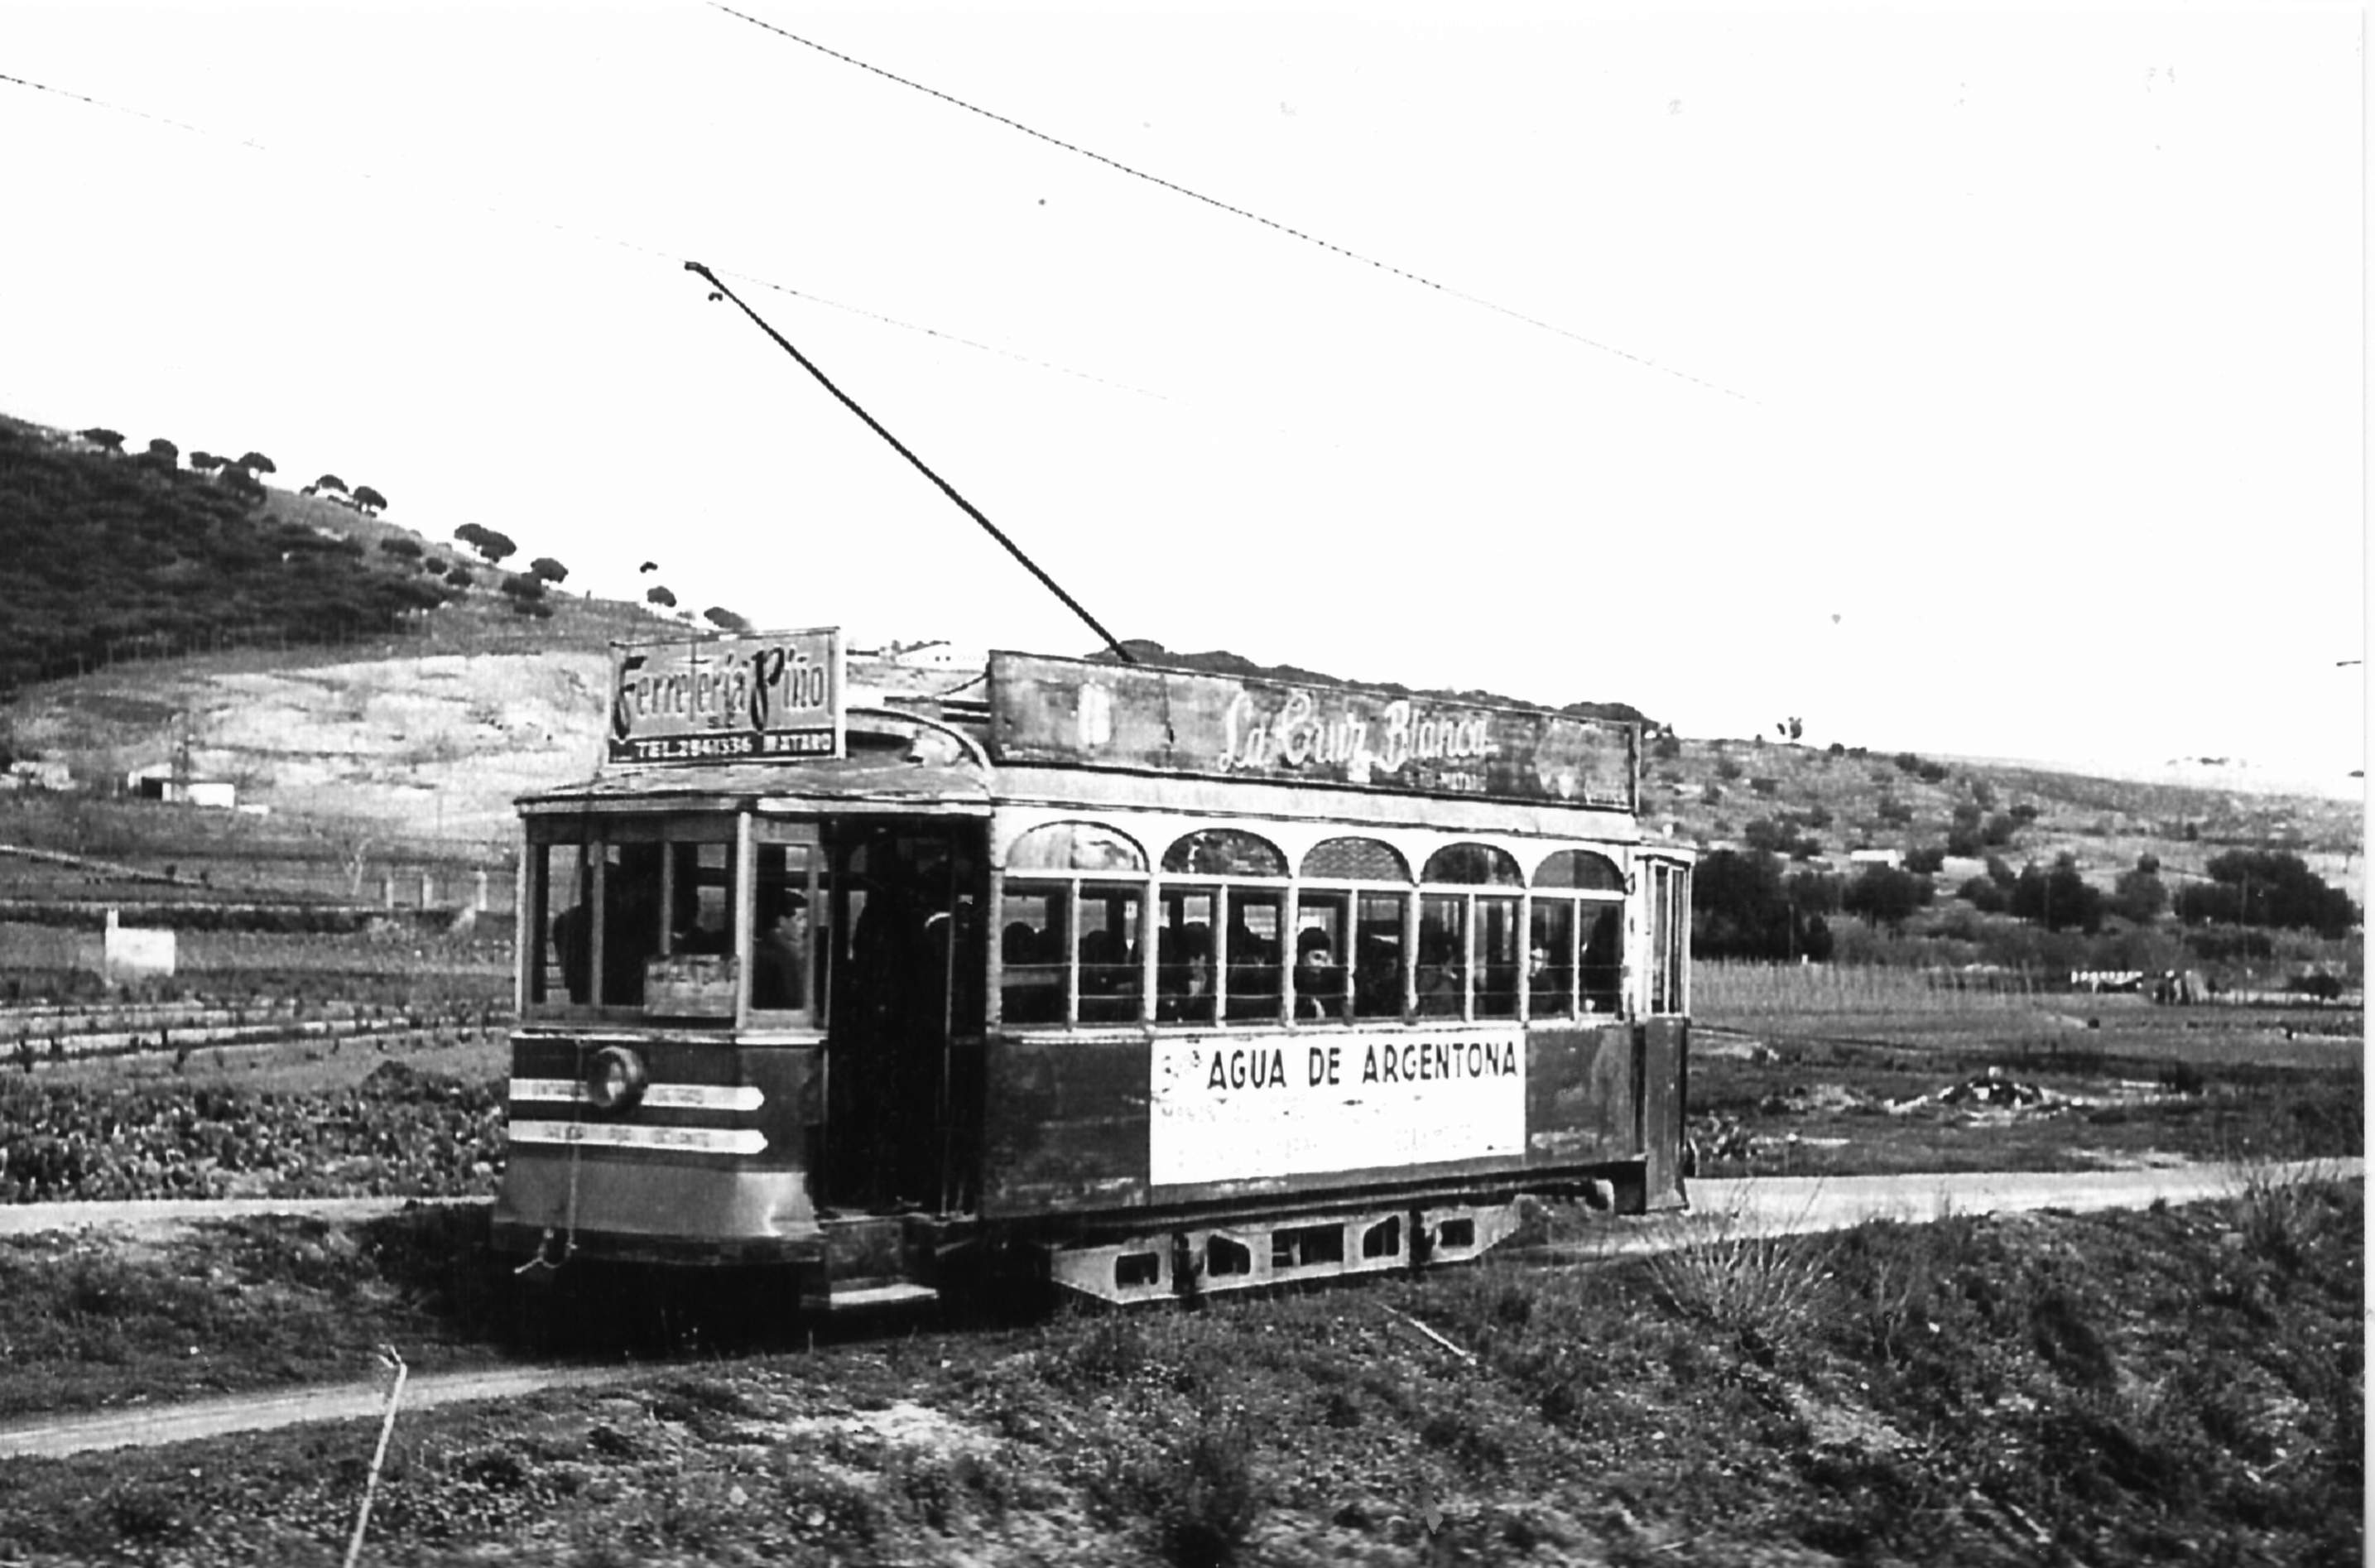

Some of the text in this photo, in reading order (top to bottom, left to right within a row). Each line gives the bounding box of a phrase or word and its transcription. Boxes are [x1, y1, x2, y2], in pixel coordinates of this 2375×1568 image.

[1218, 690, 1498, 772] La Cruz Blanca
[1207, 1047, 1287, 1090] AGUA
[1308, 1046, 1342, 1087] DE
[1362, 1041, 1518, 1084] ARGENTONA
